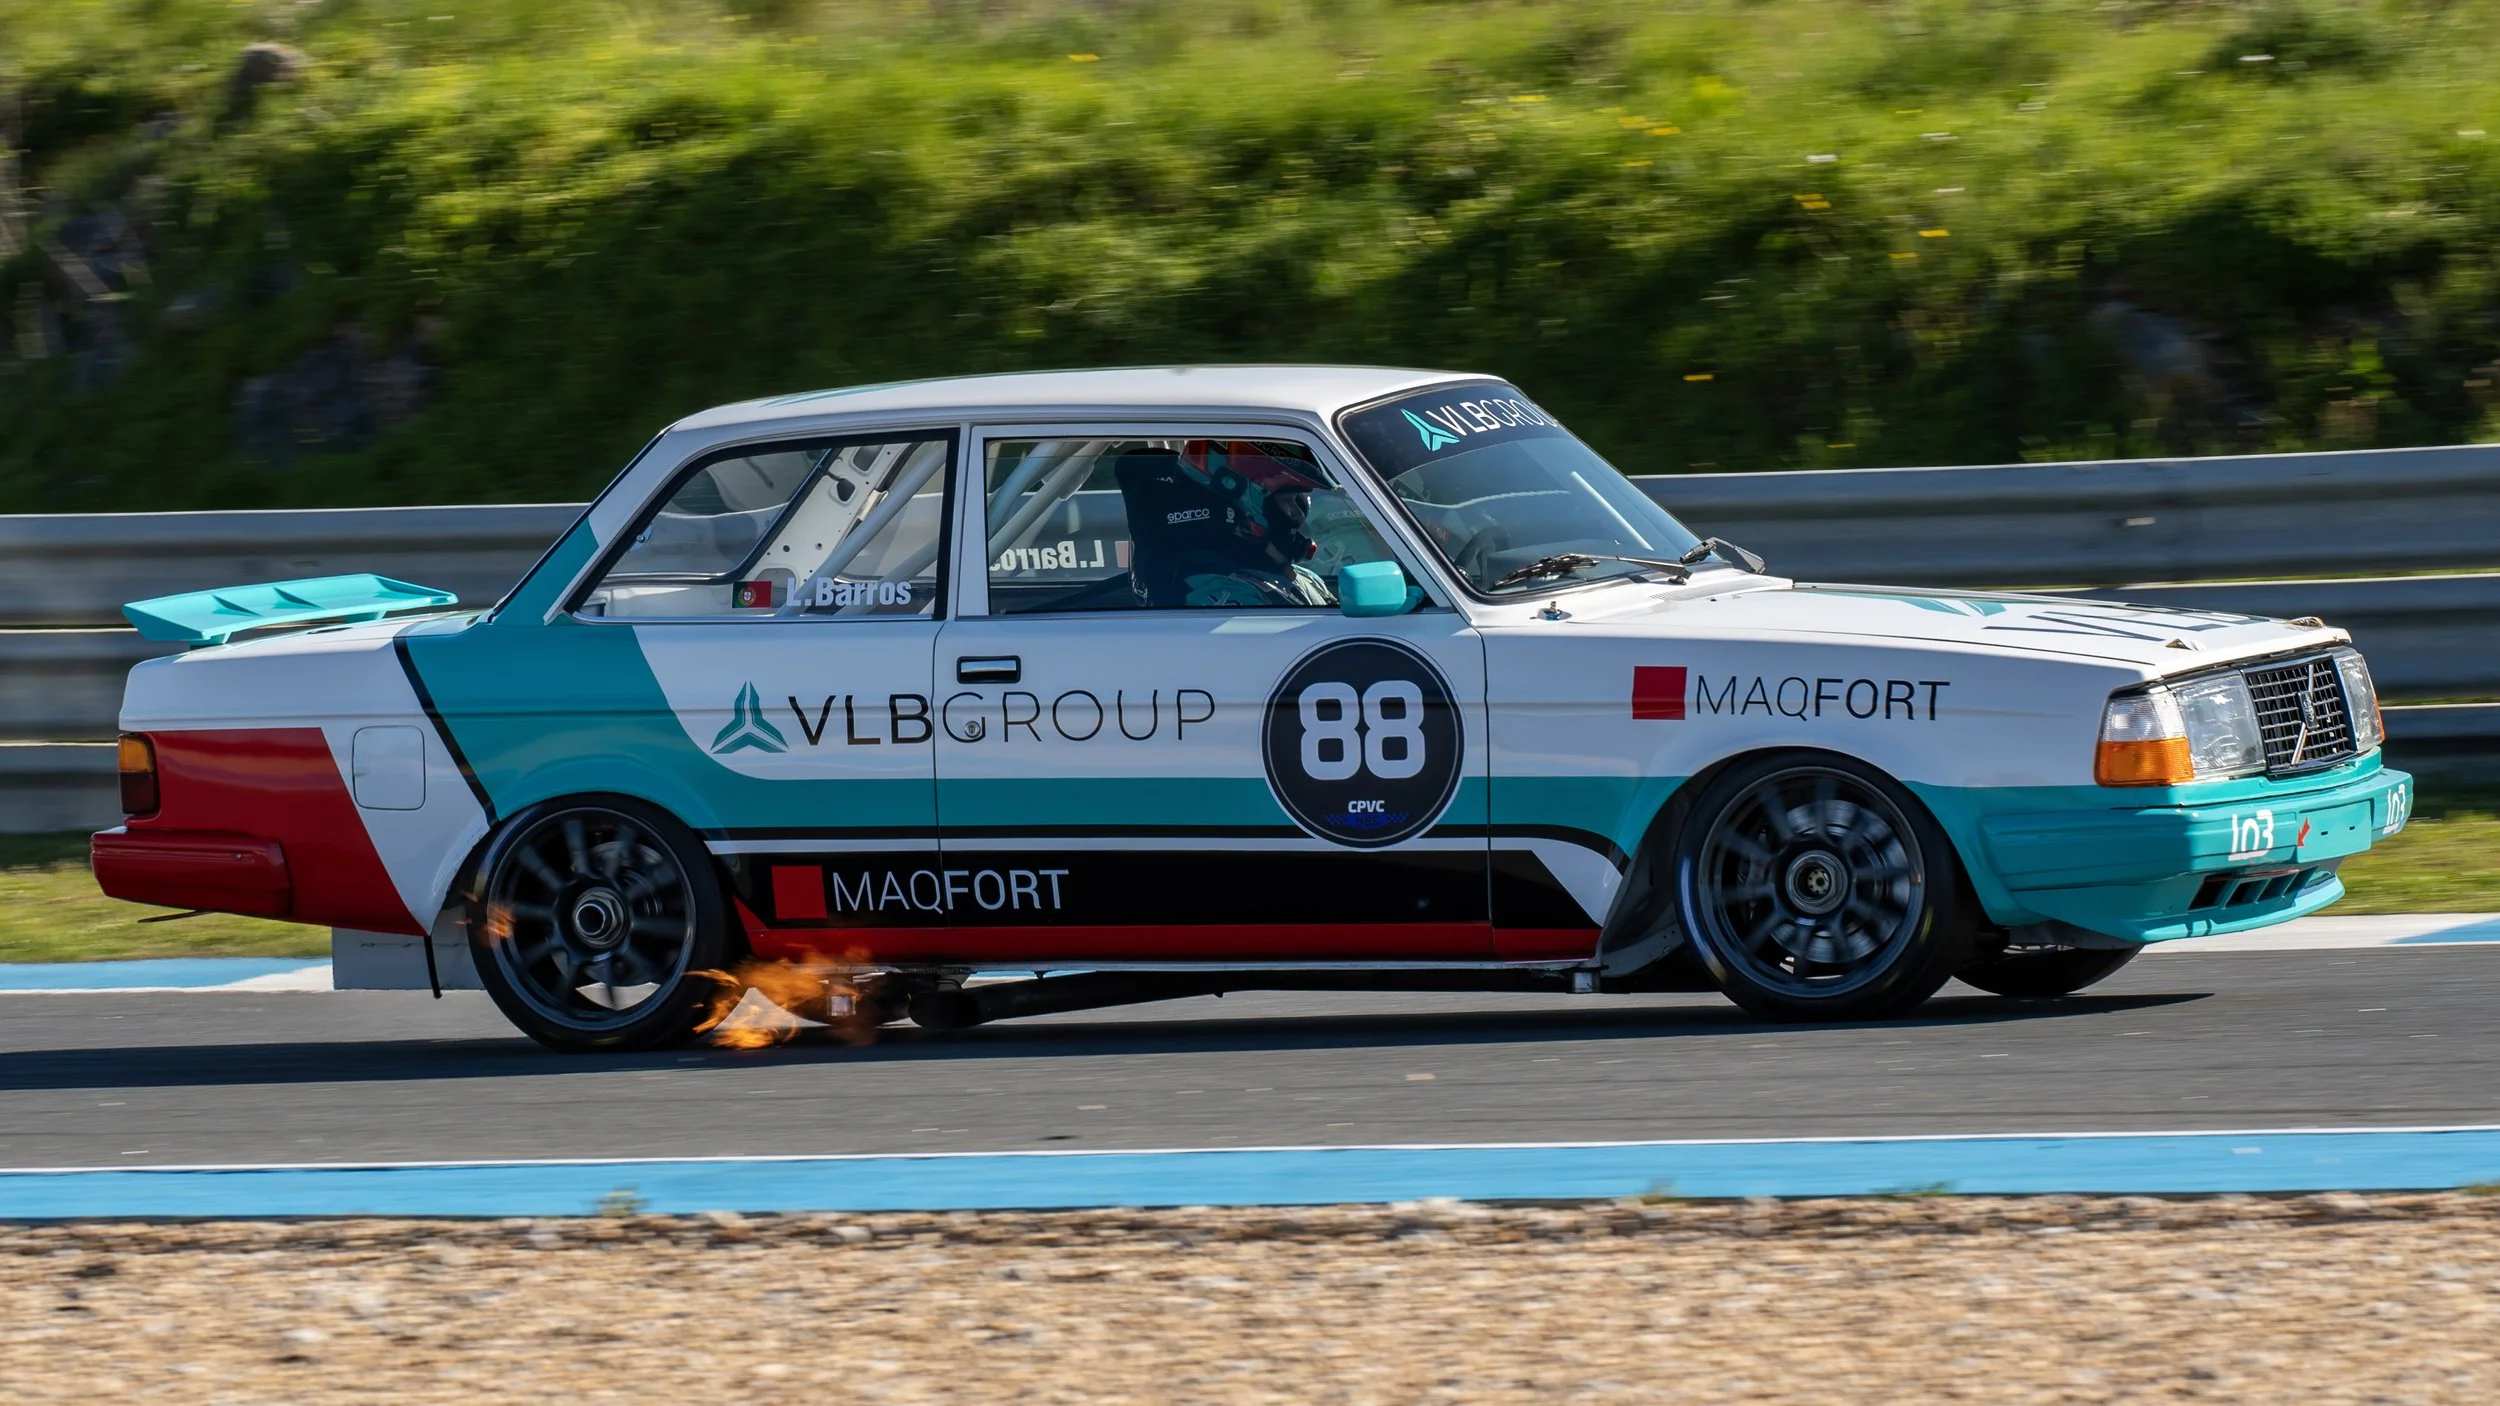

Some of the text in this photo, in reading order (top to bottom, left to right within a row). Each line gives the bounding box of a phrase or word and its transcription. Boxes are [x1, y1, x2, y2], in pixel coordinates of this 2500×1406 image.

[1167, 507, 1210, 524] sparco
[787, 689, 1216, 746] VLBGROUP
[1695, 674, 1951, 722] MAQFORT
[1298, 680, 1426, 781] 88
[1348, 800, 1385, 814] CPVC
[832, 869, 1070, 916] MAQFORT
